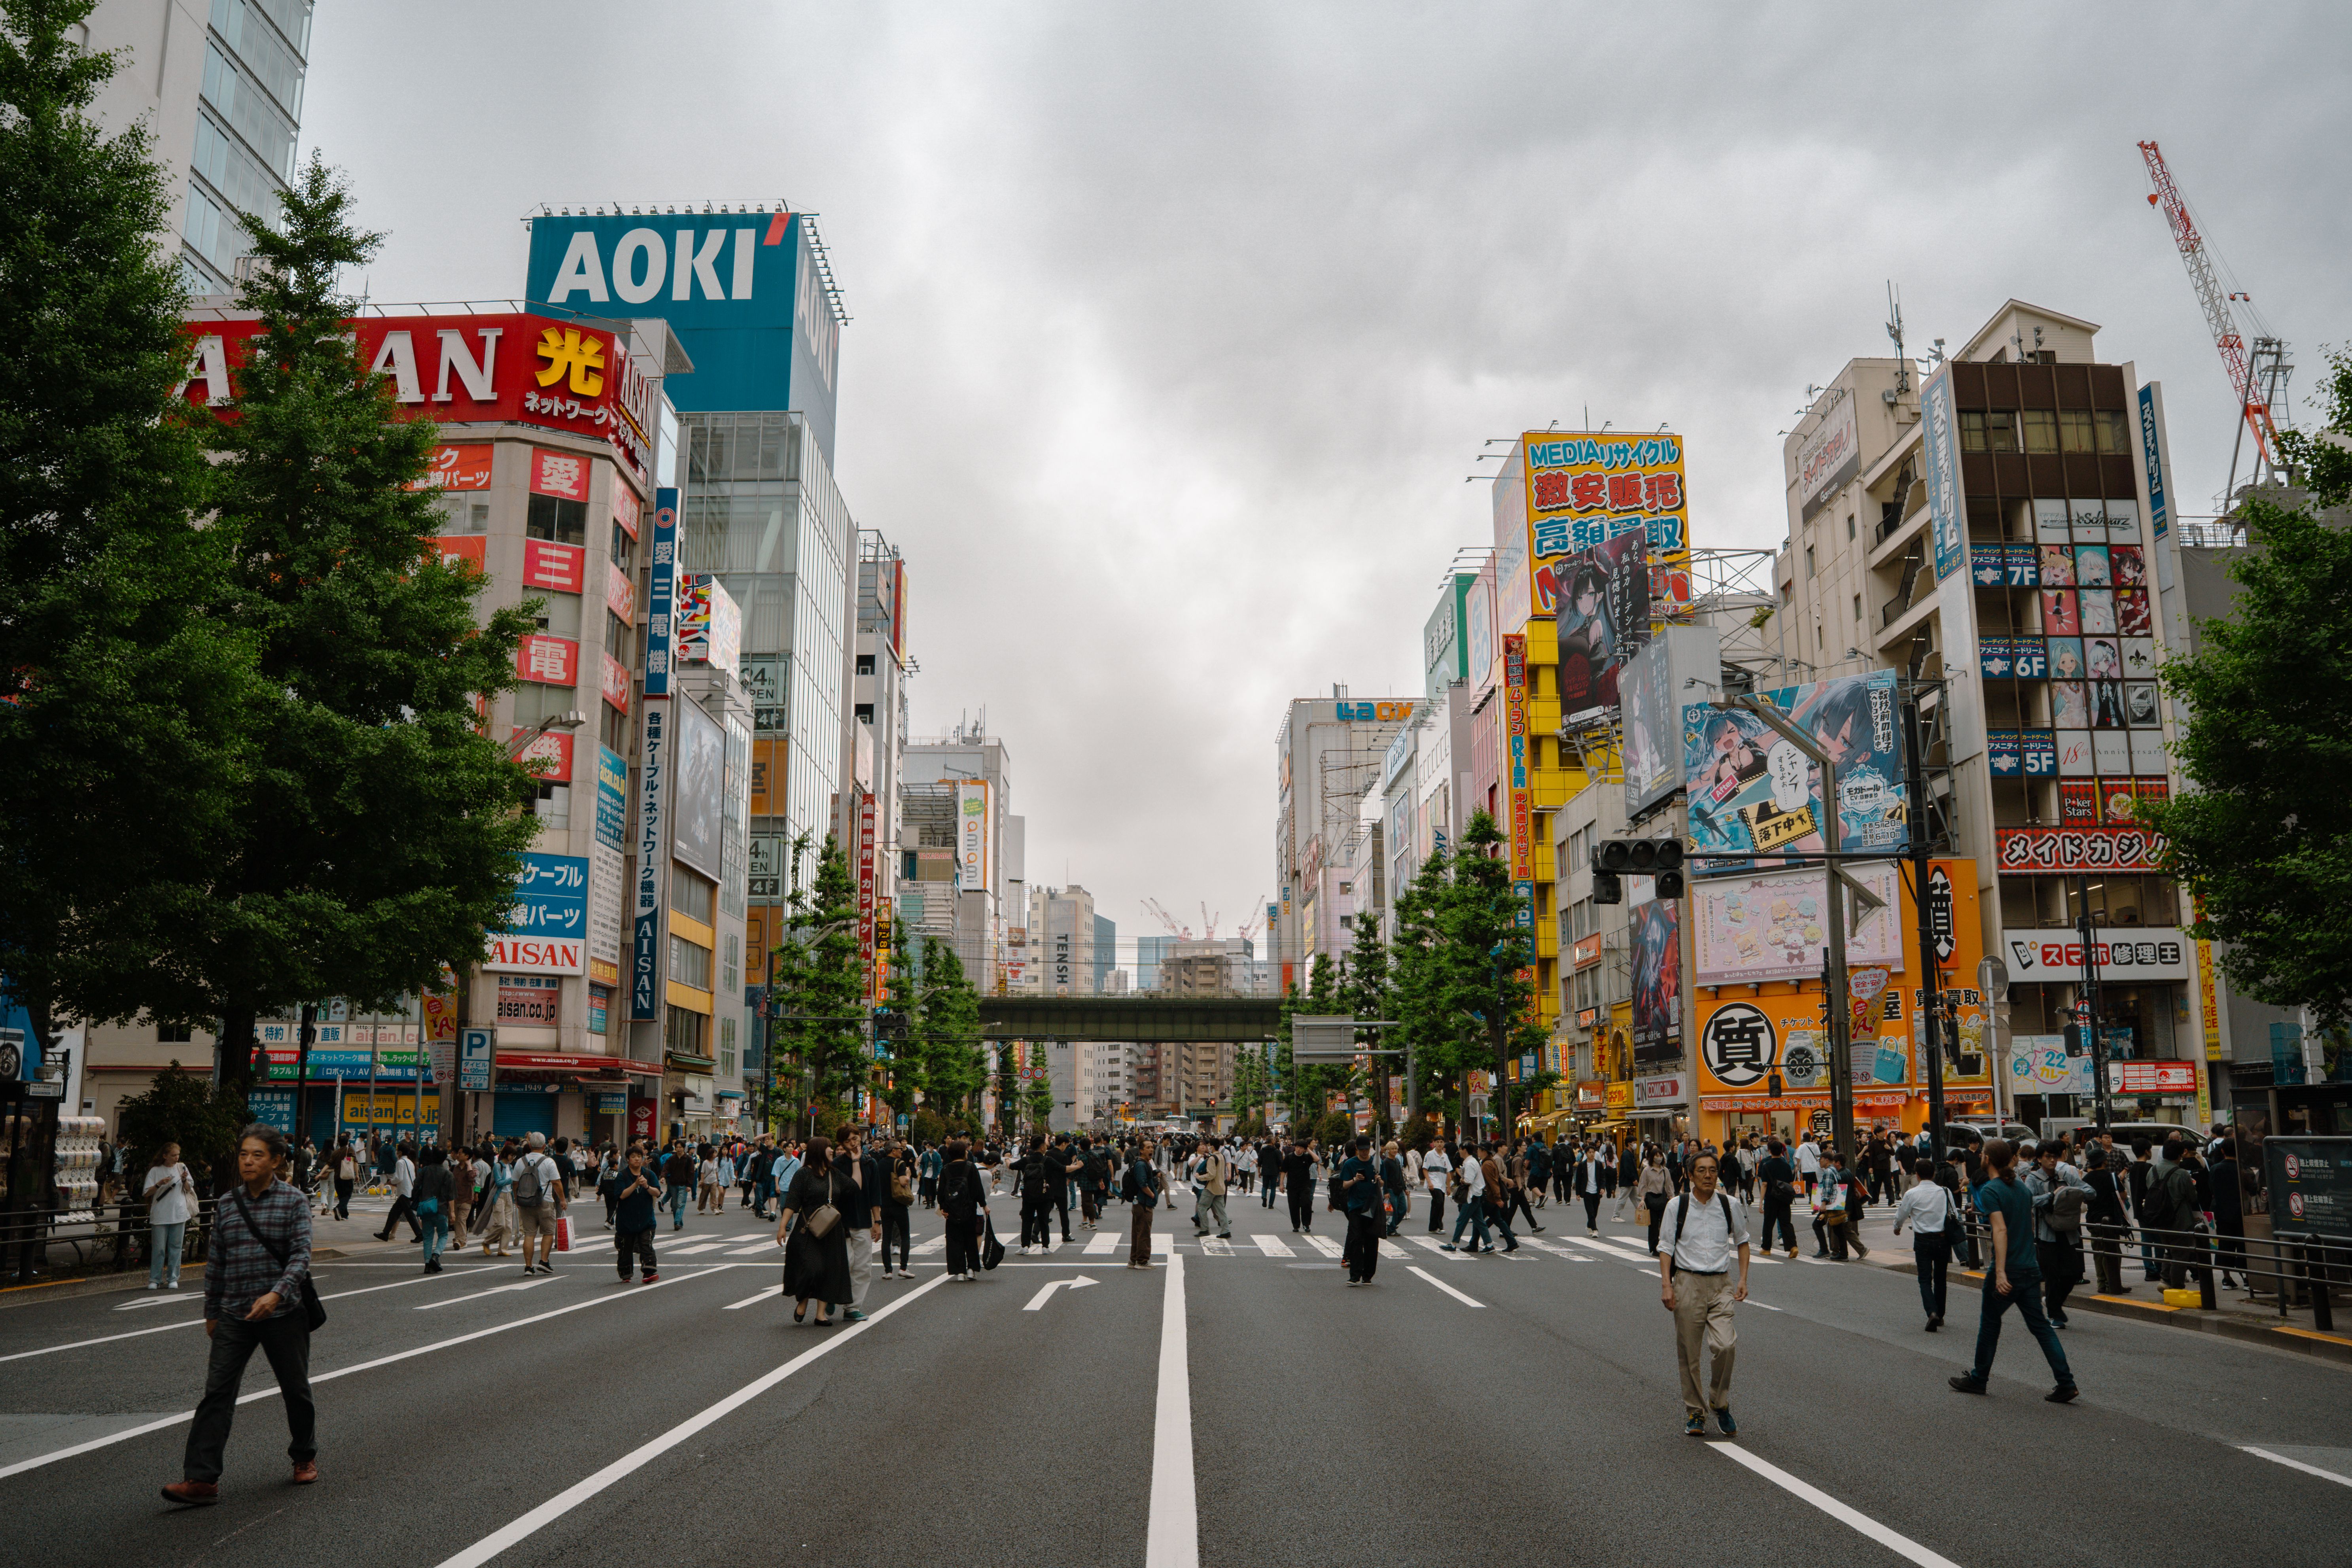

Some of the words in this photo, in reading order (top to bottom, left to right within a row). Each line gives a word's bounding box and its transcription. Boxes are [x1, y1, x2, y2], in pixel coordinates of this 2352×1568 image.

[547, 227, 755, 302] AOKI
[799, 252, 833, 393] AOKI
[535, 325, 606, 396] 光
[620, 350, 655, 442] AISAN
[525, 392, 609, 426] ネットワーク
[1529, 438, 1680, 469] MEDIAリサイクル
[1804, 420, 1850, 493] メイドカジノ
[541, 455, 579, 496] 愛
[1533, 471, 1680, 511] 激安販売
[2008, 567, 2036, 585] 7F
[648, 541, 673, 675] 愛三電機
[530, 640, 567, 680] 電
[1508, 655, 1522, 665] 買取
[1508, 666, 1523, 675] 販売
[2016, 657, 2045, 677] 6F
[1508, 677, 1523, 686] 市場
[1571, 713, 1586, 721] アズレン
[1878, 690, 1892, 753] 数秒前の様子
[2025, 752, 2053, 773] 5F
[2096, 748, 2163, 757] Anniversary
[600, 763, 625, 796] aisan.co.jp
[1786, 748, 1799, 793] ジャンプ
[1715, 778, 1734, 798] After
[1847, 784, 1880, 795] モガドール
[640, 712, 662, 908] 各種ケーブル・ネットワーク機器
[2066, 807, 2092, 816] Stars
[861, 803, 874, 869] 曲数世界一
[1758, 817, 1795, 843] 落下中
[1875, 832, 1900, 840] 6月10日
[967, 821, 978, 883] amiami
[489, 941, 579, 967] AISAN
[637, 921, 653, 1009] AISAN
[2042, 943, 2180, 966] スマホ修理王
[2205, 944, 2214, 978] TAX
[499, 976, 510, 986] 各社
[514, 976, 526, 987] 特約
[529, 978, 541, 987] 在庫
[545, 978, 557, 988] 直販
[878, 963, 889, 1003] DVD
[497, 998, 556, 1022] aisan.co.jp
[2209, 984, 2218, 1028] FREE
[1780, 1015, 1814, 1028] チケット
[265, 1026, 284, 1041] 特約
[321, 1027, 340, 1042] 直販
[467, 1033, 486, 1056] P
[1711, 1013, 1766, 1076] 質
[532, 1057, 579, 1065] www.aisan.co.jp
[2045, 1051, 2066, 1069] 22
[2186, 1068, 2195, 1084] 免税
[1648, 1083, 1663, 1097] COMIC
[1875, 1095, 1905, 1105] 無料査定
[1703, 1101, 1730, 1110] 高価買取
[2299, 1159, 2329, 1167] 路上喫煙禁止
[2303, 1194, 2334, 1204] 路上駐輪禁止
